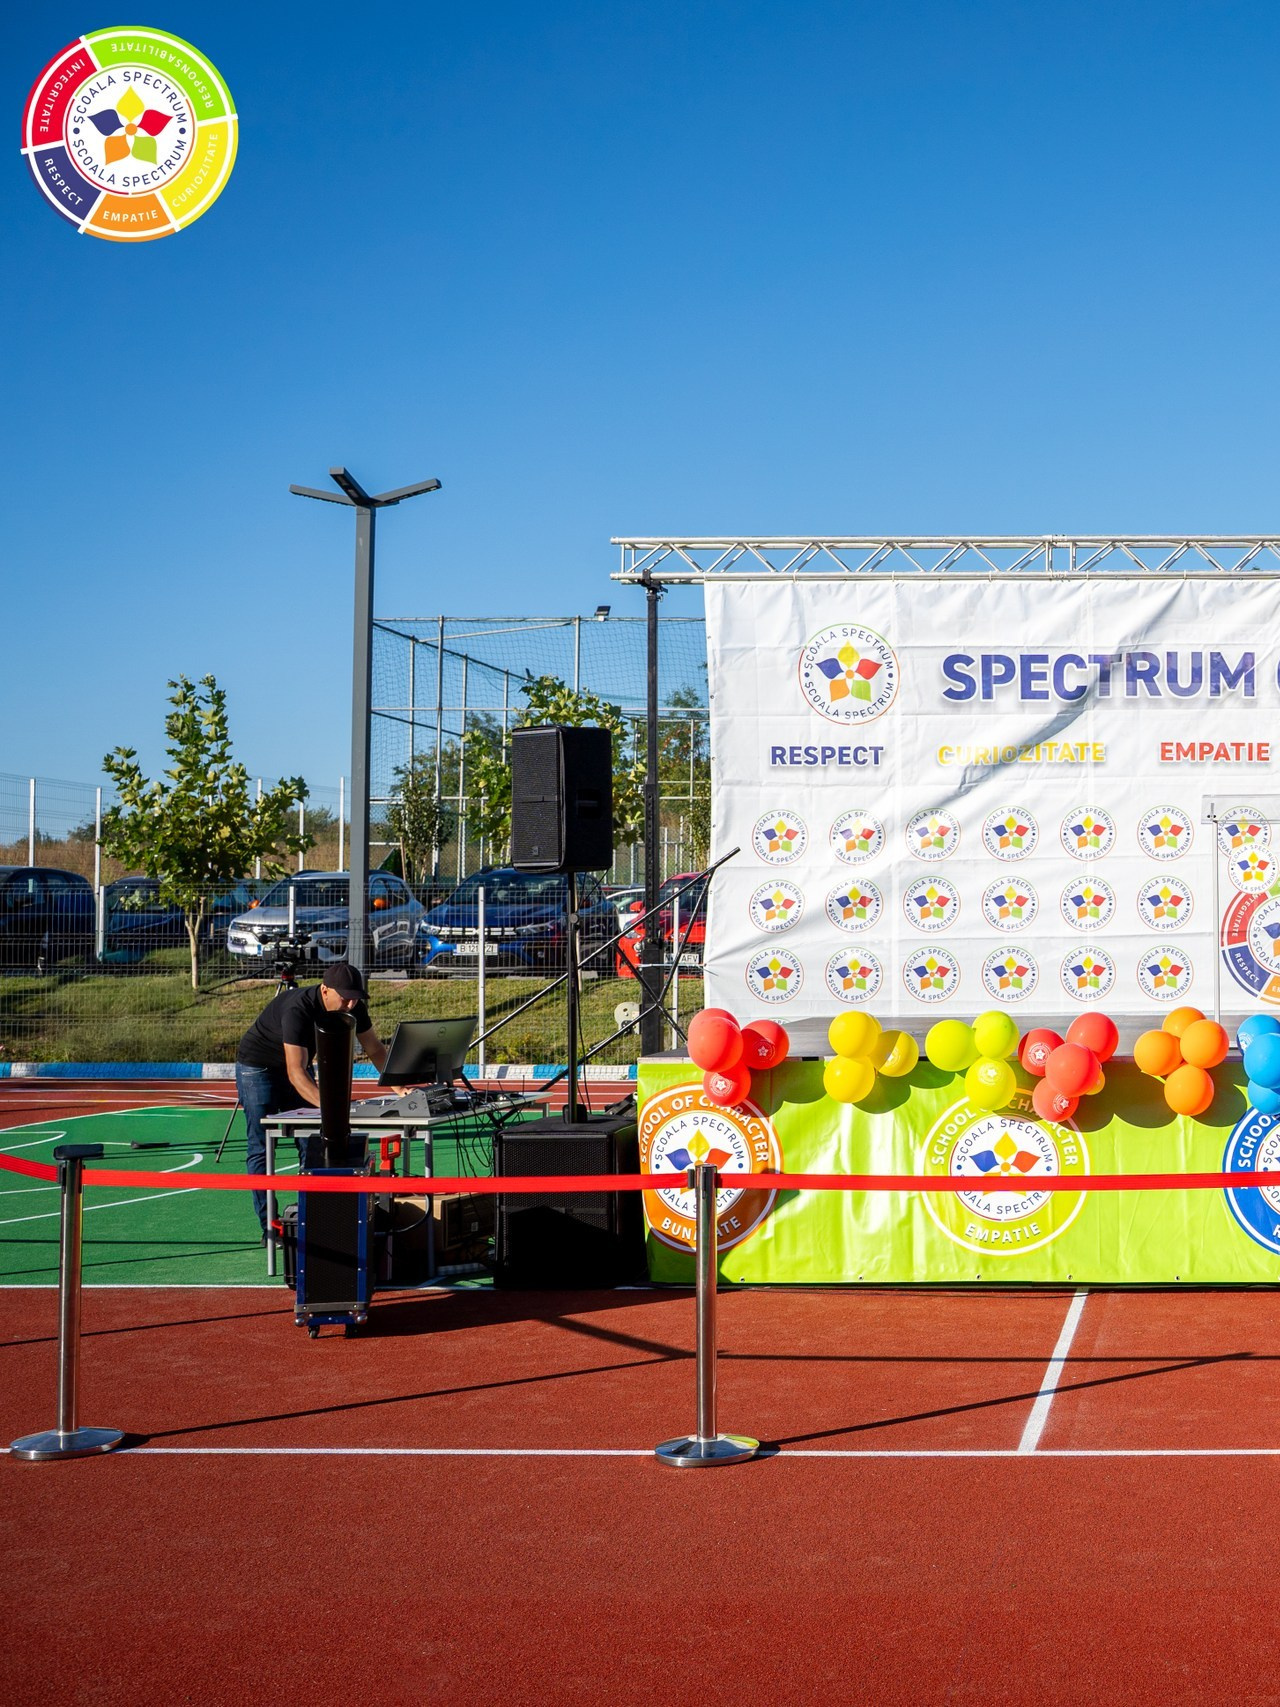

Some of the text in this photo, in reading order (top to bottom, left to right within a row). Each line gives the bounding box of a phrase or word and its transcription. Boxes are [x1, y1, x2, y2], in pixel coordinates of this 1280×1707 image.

[842, 628, 894, 670] SPECTRUM
[942, 651, 1257, 701] SPECTRUM
[844, 682, 894, 720] SPECTRUM
[771, 746, 884, 765] RESPECT
[938, 742, 1105, 764] CURIOZITATE
[1160, 742, 1270, 762] EMPATIE
[777, 812, 805, 835] SPECTRUM
[1008, 808, 1036, 831] SPECTRUM
[1163, 808, 1191, 831] SPECTRUM
[777, 842, 805, 863] SPECTRUM
[1007, 838, 1036, 859] SPECTRUM
[1162, 838, 1190, 858] SPECTRUM
[929, 879, 957, 902] SPECTRUM
[1162, 878, 1190, 901] SPECTRUM
[928, 909, 957, 929] SPECTRUM
[1162, 908, 1190, 929] SPECTRUM
[772, 950, 800, 973] SPECTRUM
[1008, 949, 1036, 972] SPECTRUM
[1162, 948, 1190, 971] SPECTRUM
[1234, 952, 1260, 983] RESPECT
[771, 980, 800, 1001] SPECTRUM
[1007, 979, 1036, 999] SPECTRUM
[1162, 978, 1190, 998] SPECTRUM
[641, 1105, 670, 1164] SCHOOL
[672, 1095, 694, 1110] OF
[693, 1116, 744, 1160] SPECTRUM
[932, 1108, 977, 1166] SCHOOL
[1000, 1118, 1054, 1163] SPECTRUM
[663, 1188, 688, 1210] OALA
[964, 1190, 1045, 1214] OALA SPECTR
[965, 1222, 1042, 1243] EMPATIE
